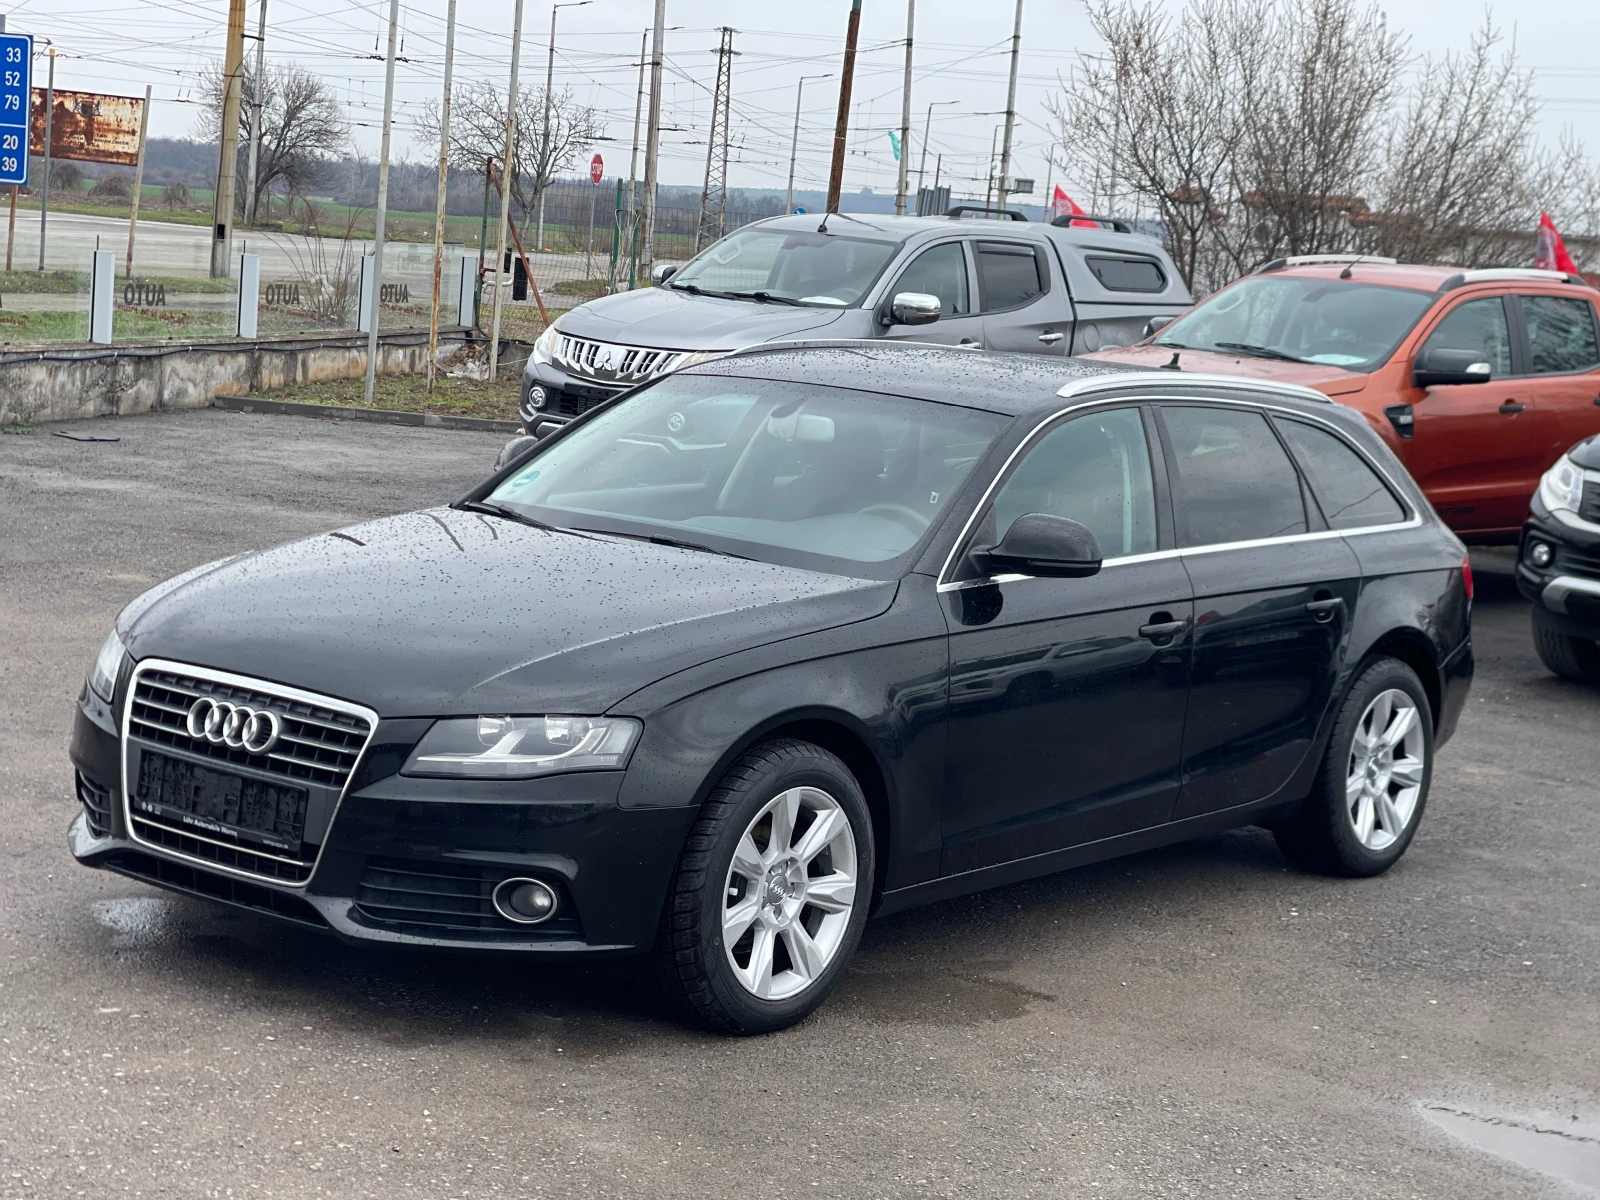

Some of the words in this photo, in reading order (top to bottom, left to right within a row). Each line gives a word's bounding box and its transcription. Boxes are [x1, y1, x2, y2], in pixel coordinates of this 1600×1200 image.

[6, 47, 21, 63] 33
[5, 71, 20, 87] 52
[4, 94, 20, 110] 79
[2, 134, 19, 150] 20
[1, 156, 18, 172] 39
[592, 163, 603, 175] STOP
